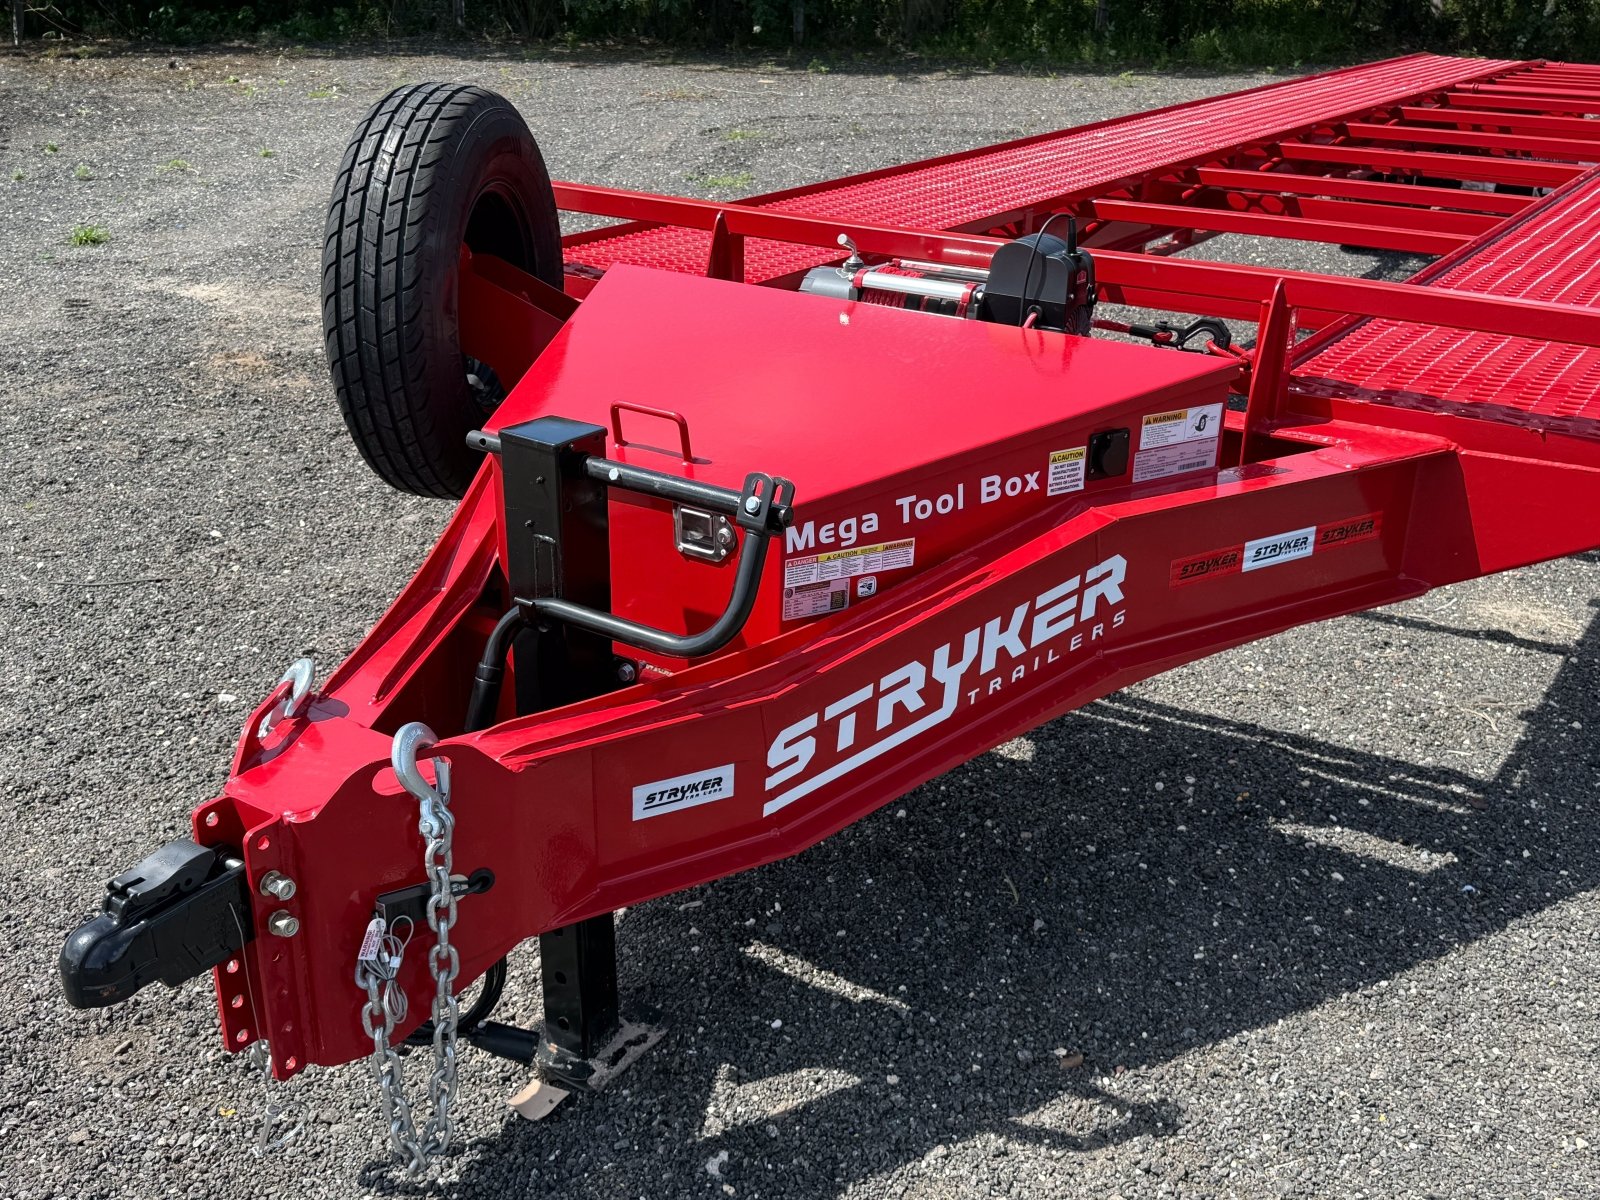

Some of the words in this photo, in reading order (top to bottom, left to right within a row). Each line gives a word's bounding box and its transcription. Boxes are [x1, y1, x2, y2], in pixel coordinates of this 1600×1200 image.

[1152, 413, 1182, 424] WARNING
[1057, 451, 1084, 462] CAUTION
[786, 511, 879, 554] Mega
[896, 483, 964, 525] Tool
[980, 470, 1040, 505] Box
[1320, 520, 1375, 545] STRYKER
[793, 557, 817, 567] DANGER
[832, 550, 858, 560] CAUTION
[1252, 536, 1309, 563] STRYKER
[1281, 546, 1308, 555] TRALERS
[1178, 553, 1238, 580] STRYKER
[967, 610, 1126, 705] TRAILERS
[763, 554, 1128, 818] STRYKER
[643, 776, 723, 811] STRYKER
[685, 787, 723, 801] TRALERS
